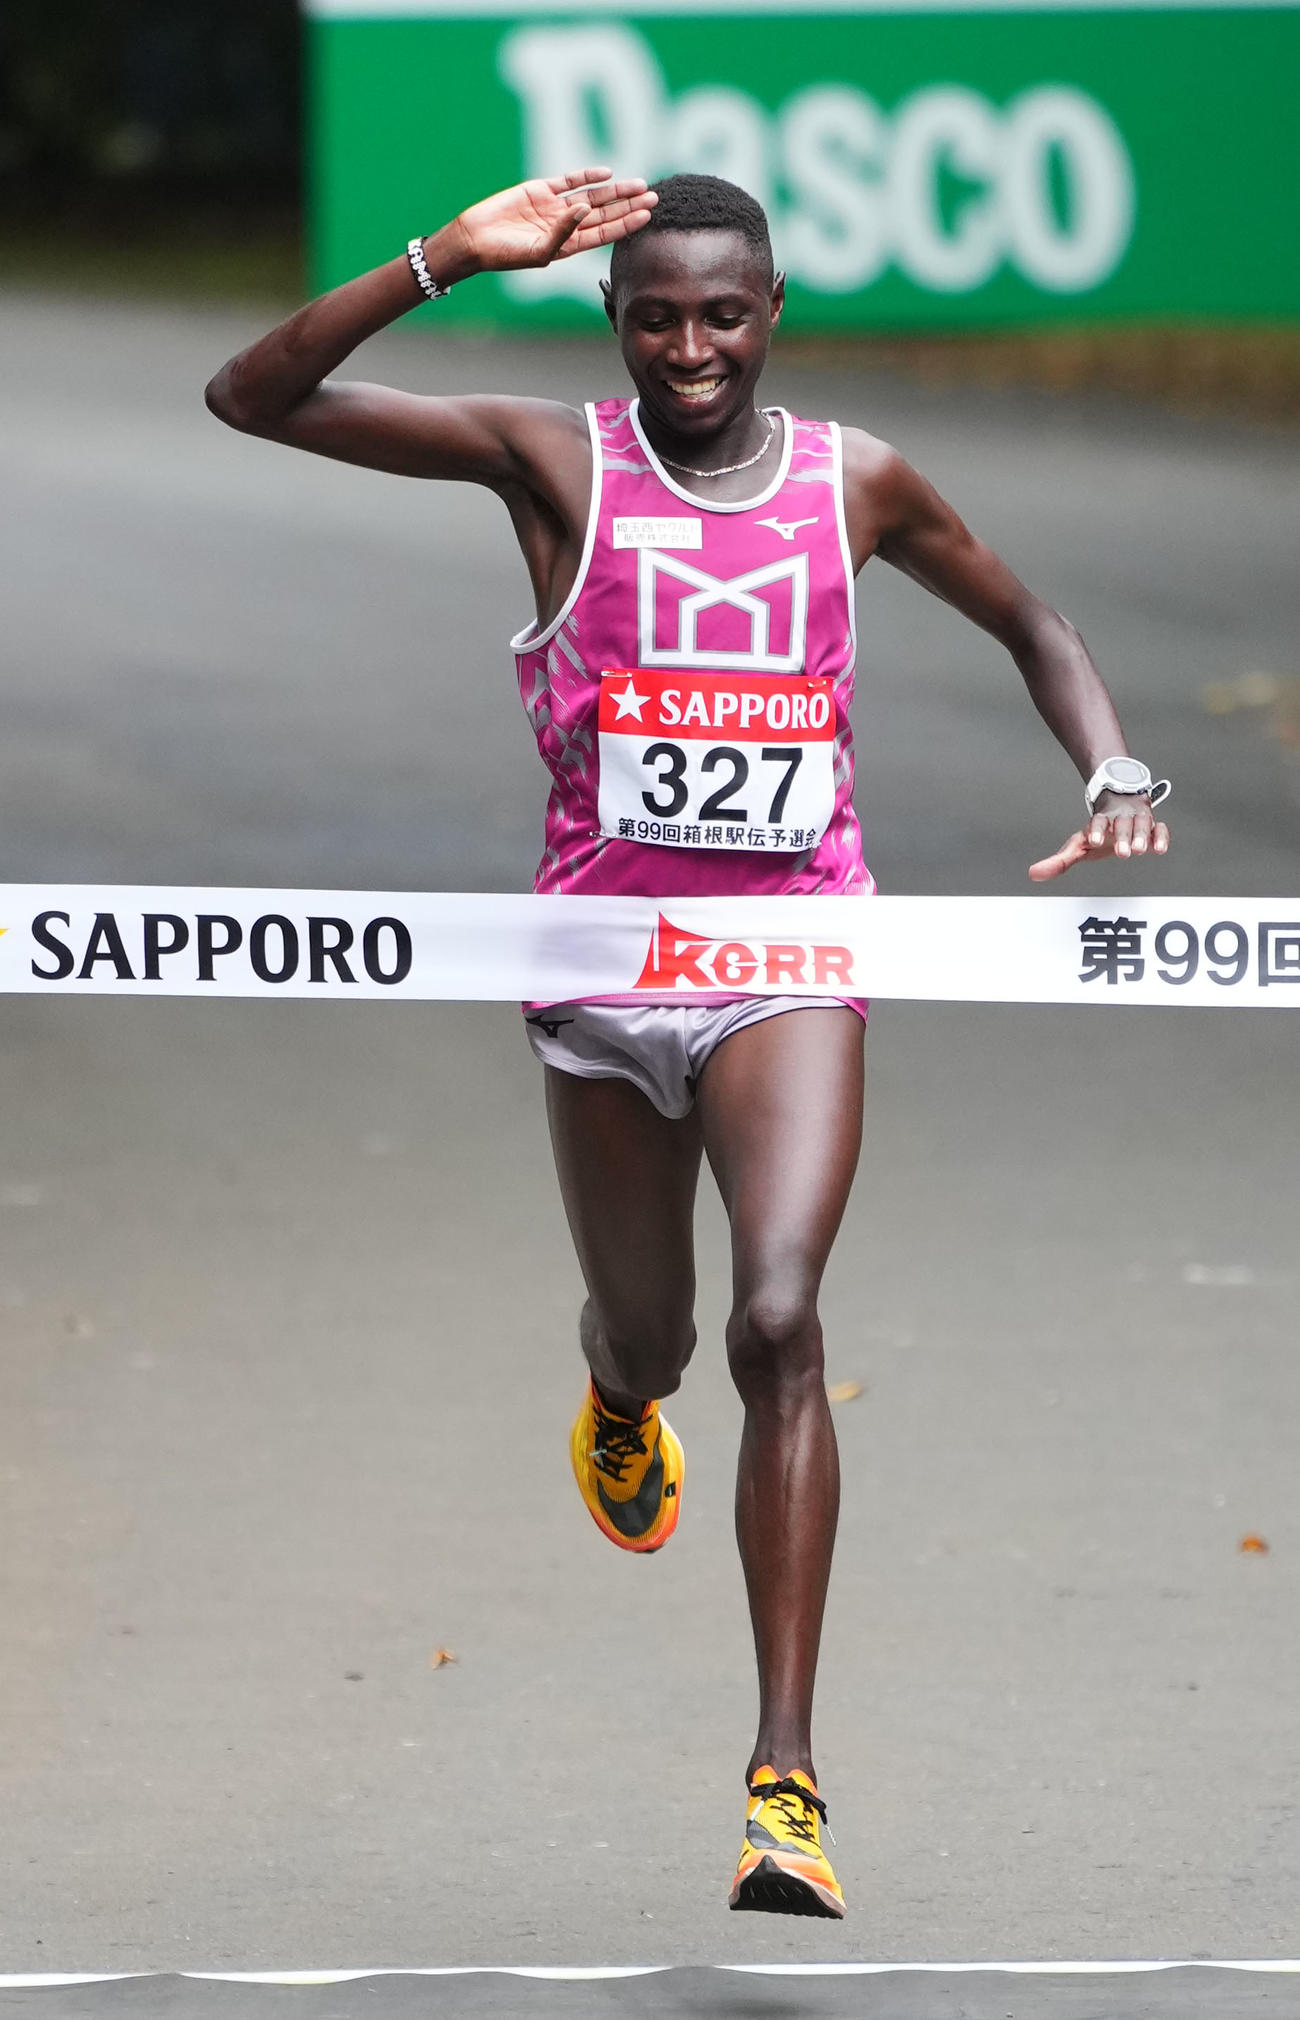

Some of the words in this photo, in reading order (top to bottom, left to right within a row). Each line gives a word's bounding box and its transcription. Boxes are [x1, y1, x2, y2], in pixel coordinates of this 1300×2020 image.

[658, 689, 830, 729] SAPPORO
[641, 742, 804, 824] 327
[618, 817, 818, 848] 第99回箱根駅伝予選会
[31, 910, 413, 984] SAPPORO
[1077, 916, 1300, 987] 第99回
